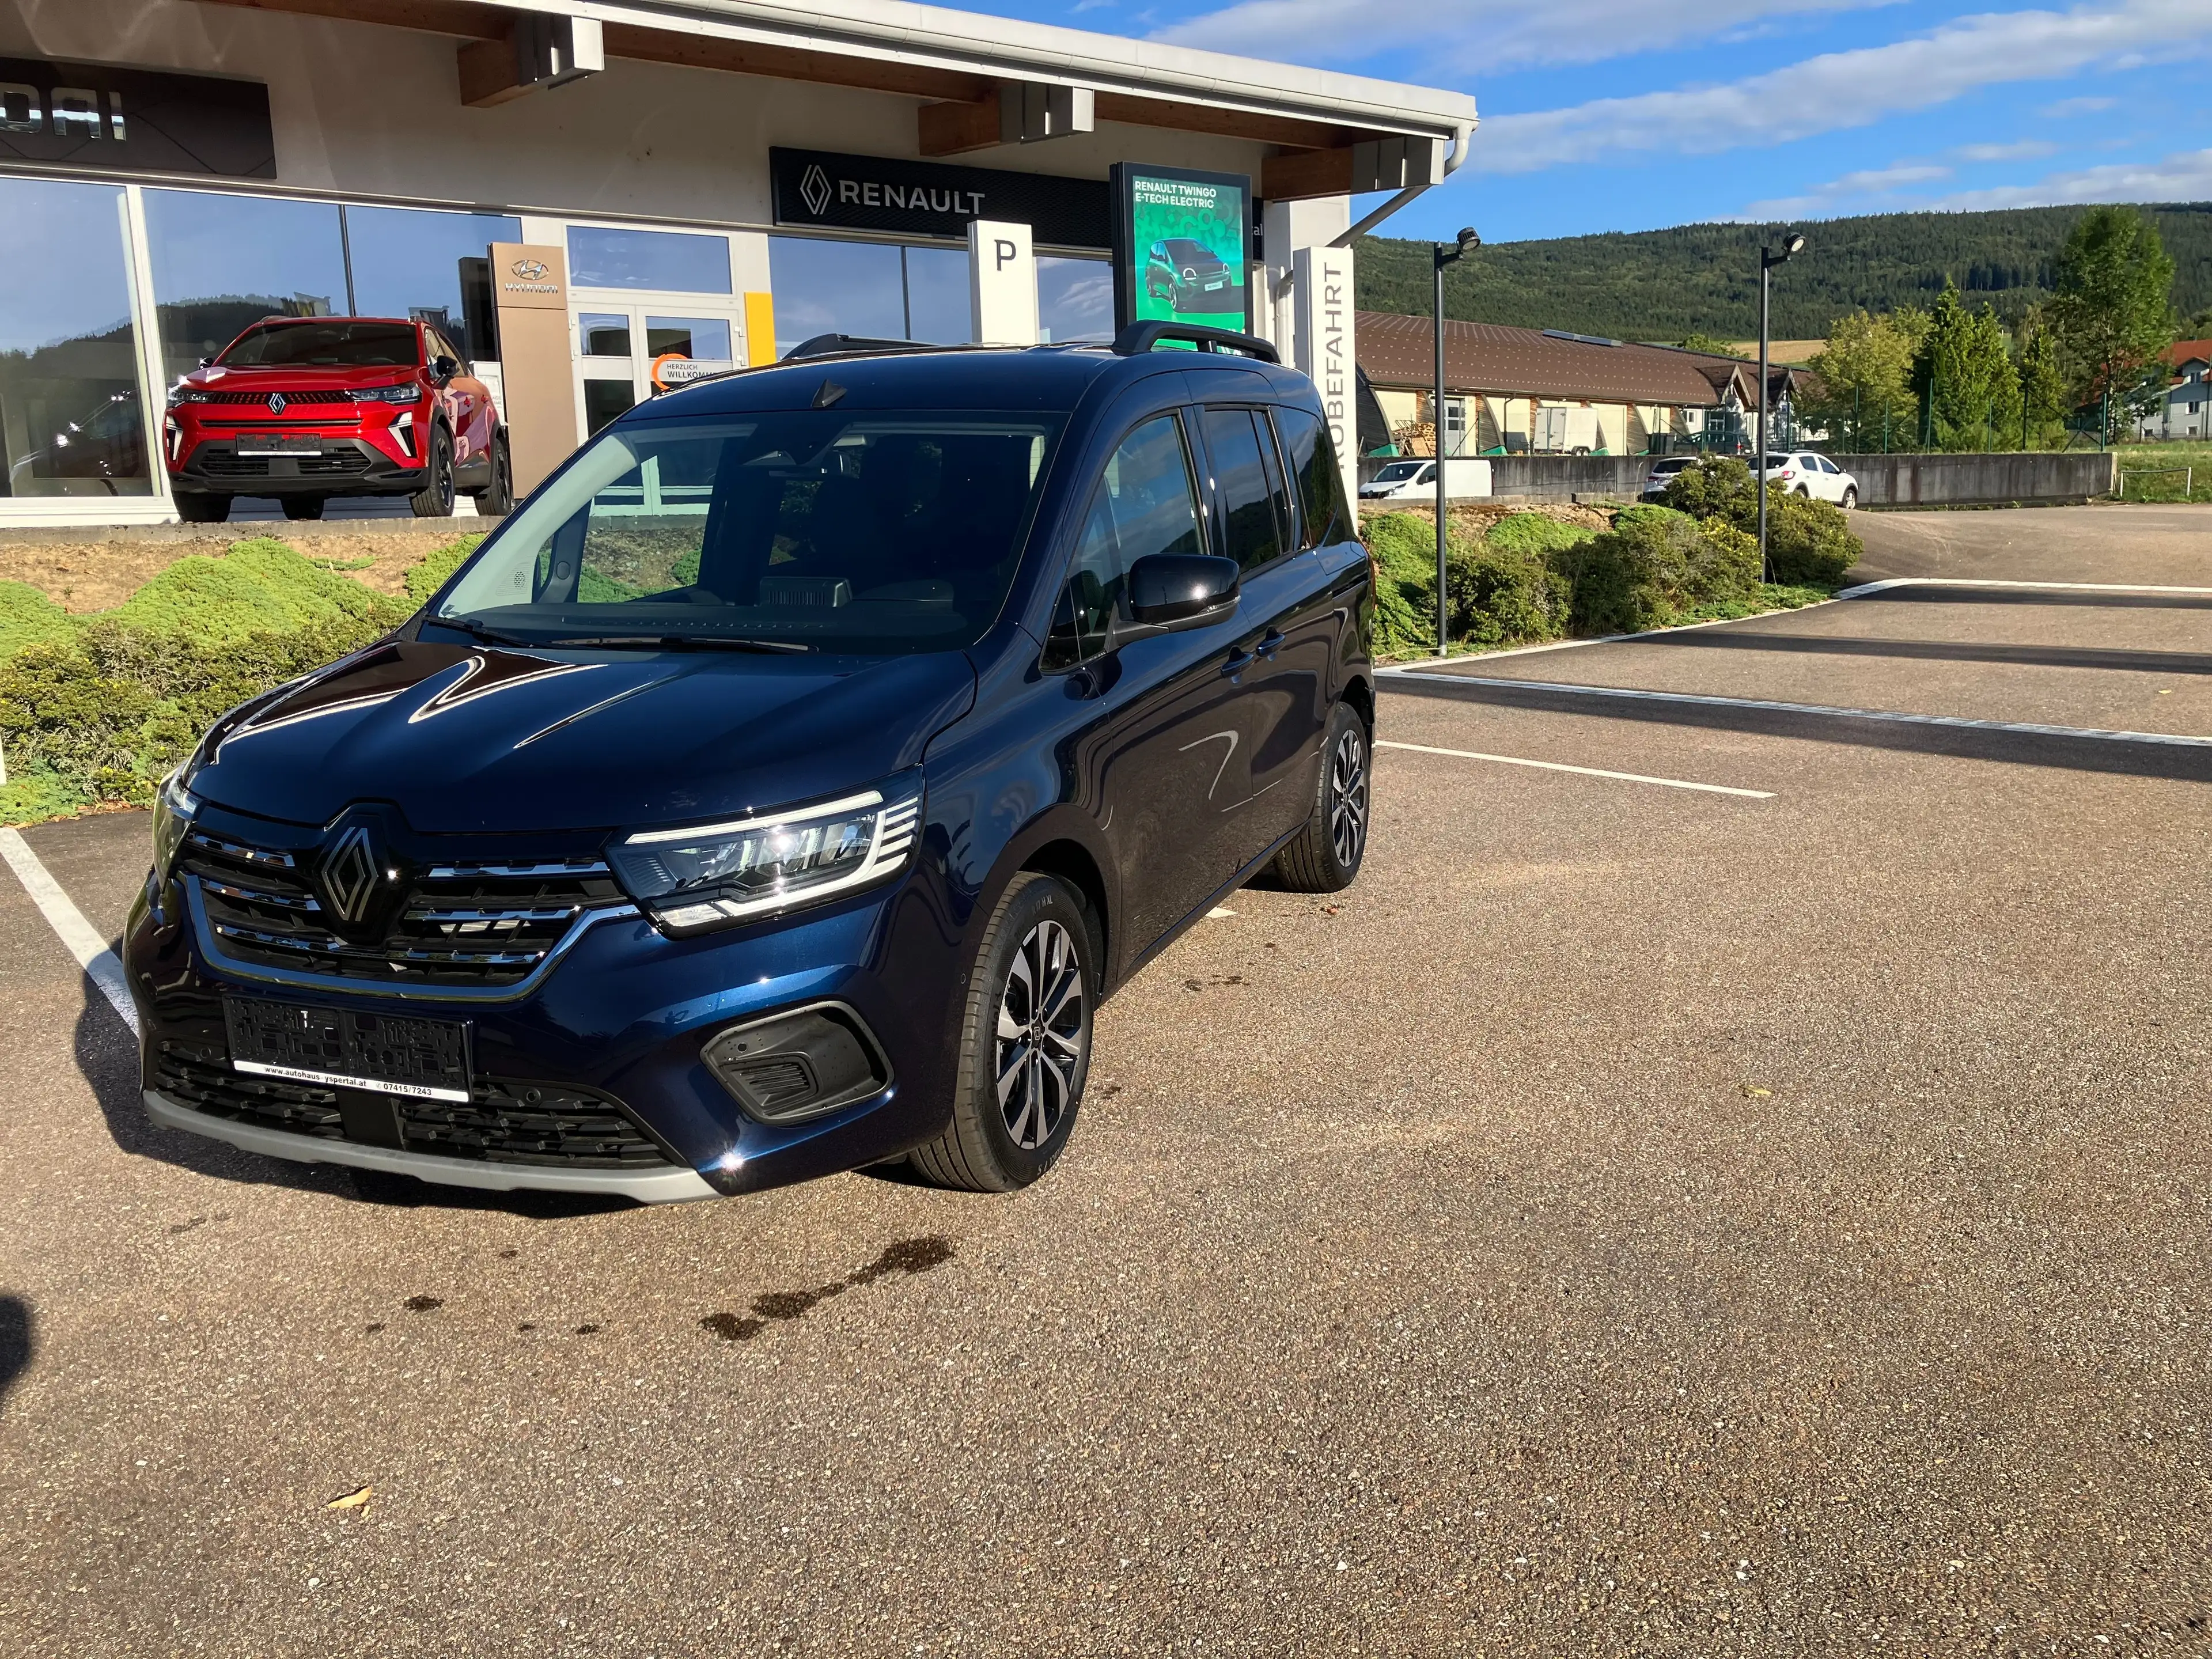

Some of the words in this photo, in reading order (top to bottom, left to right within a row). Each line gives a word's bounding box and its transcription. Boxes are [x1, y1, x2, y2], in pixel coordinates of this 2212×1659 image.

[839, 180, 985, 215] RENAULT
[1135, 180, 1177, 194] RENAULT
[1178, 185, 1217, 198] TWINGO
[1135, 192, 1169, 204] E-TECH
[1171, 196, 1214, 209] ELECTRIC
[1251, 224, 1263, 236] al
[994, 239, 1016, 271] P
[505, 283, 558, 294] HYUNDAI
[1324, 262, 1344, 469] OBEFAHRT
[384, 1083, 431, 1096] 07415/7243
